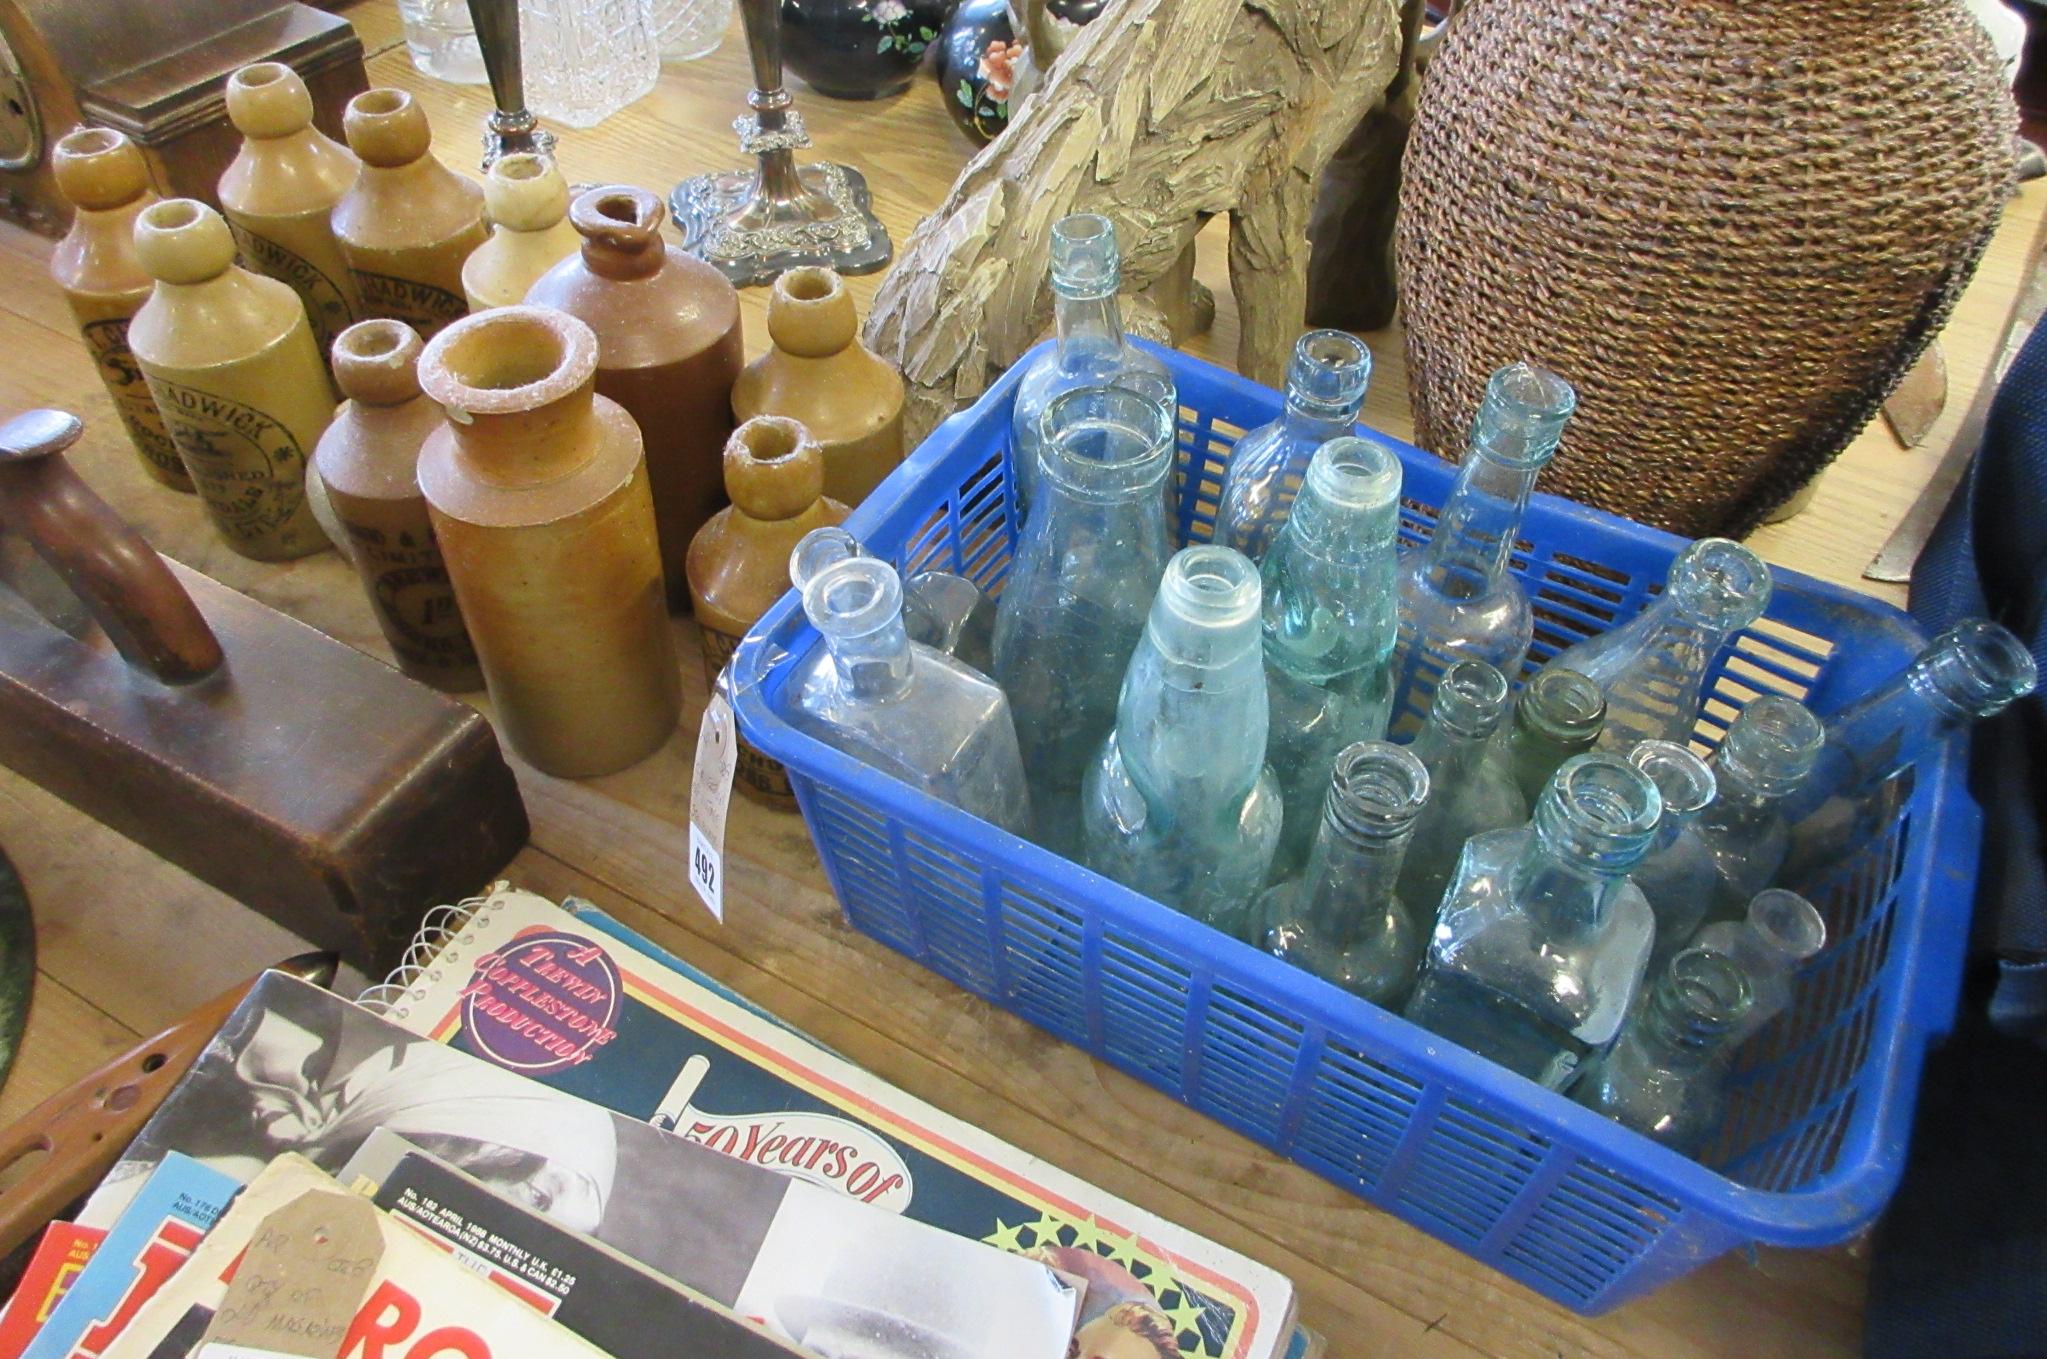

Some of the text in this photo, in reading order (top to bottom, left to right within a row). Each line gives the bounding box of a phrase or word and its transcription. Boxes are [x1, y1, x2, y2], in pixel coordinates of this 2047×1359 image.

[694, 846, 715, 894] 492
[566, 946, 605, 968] A
[459, 978, 594, 1066] PRODUCTION
[473, 952, 618, 1046] COPPLESTONE
[438, 1207, 464, 1227] APRIL
[488, 1234, 531, 1261] MONTHLY
[527, 1266, 548, 1283] CAN
